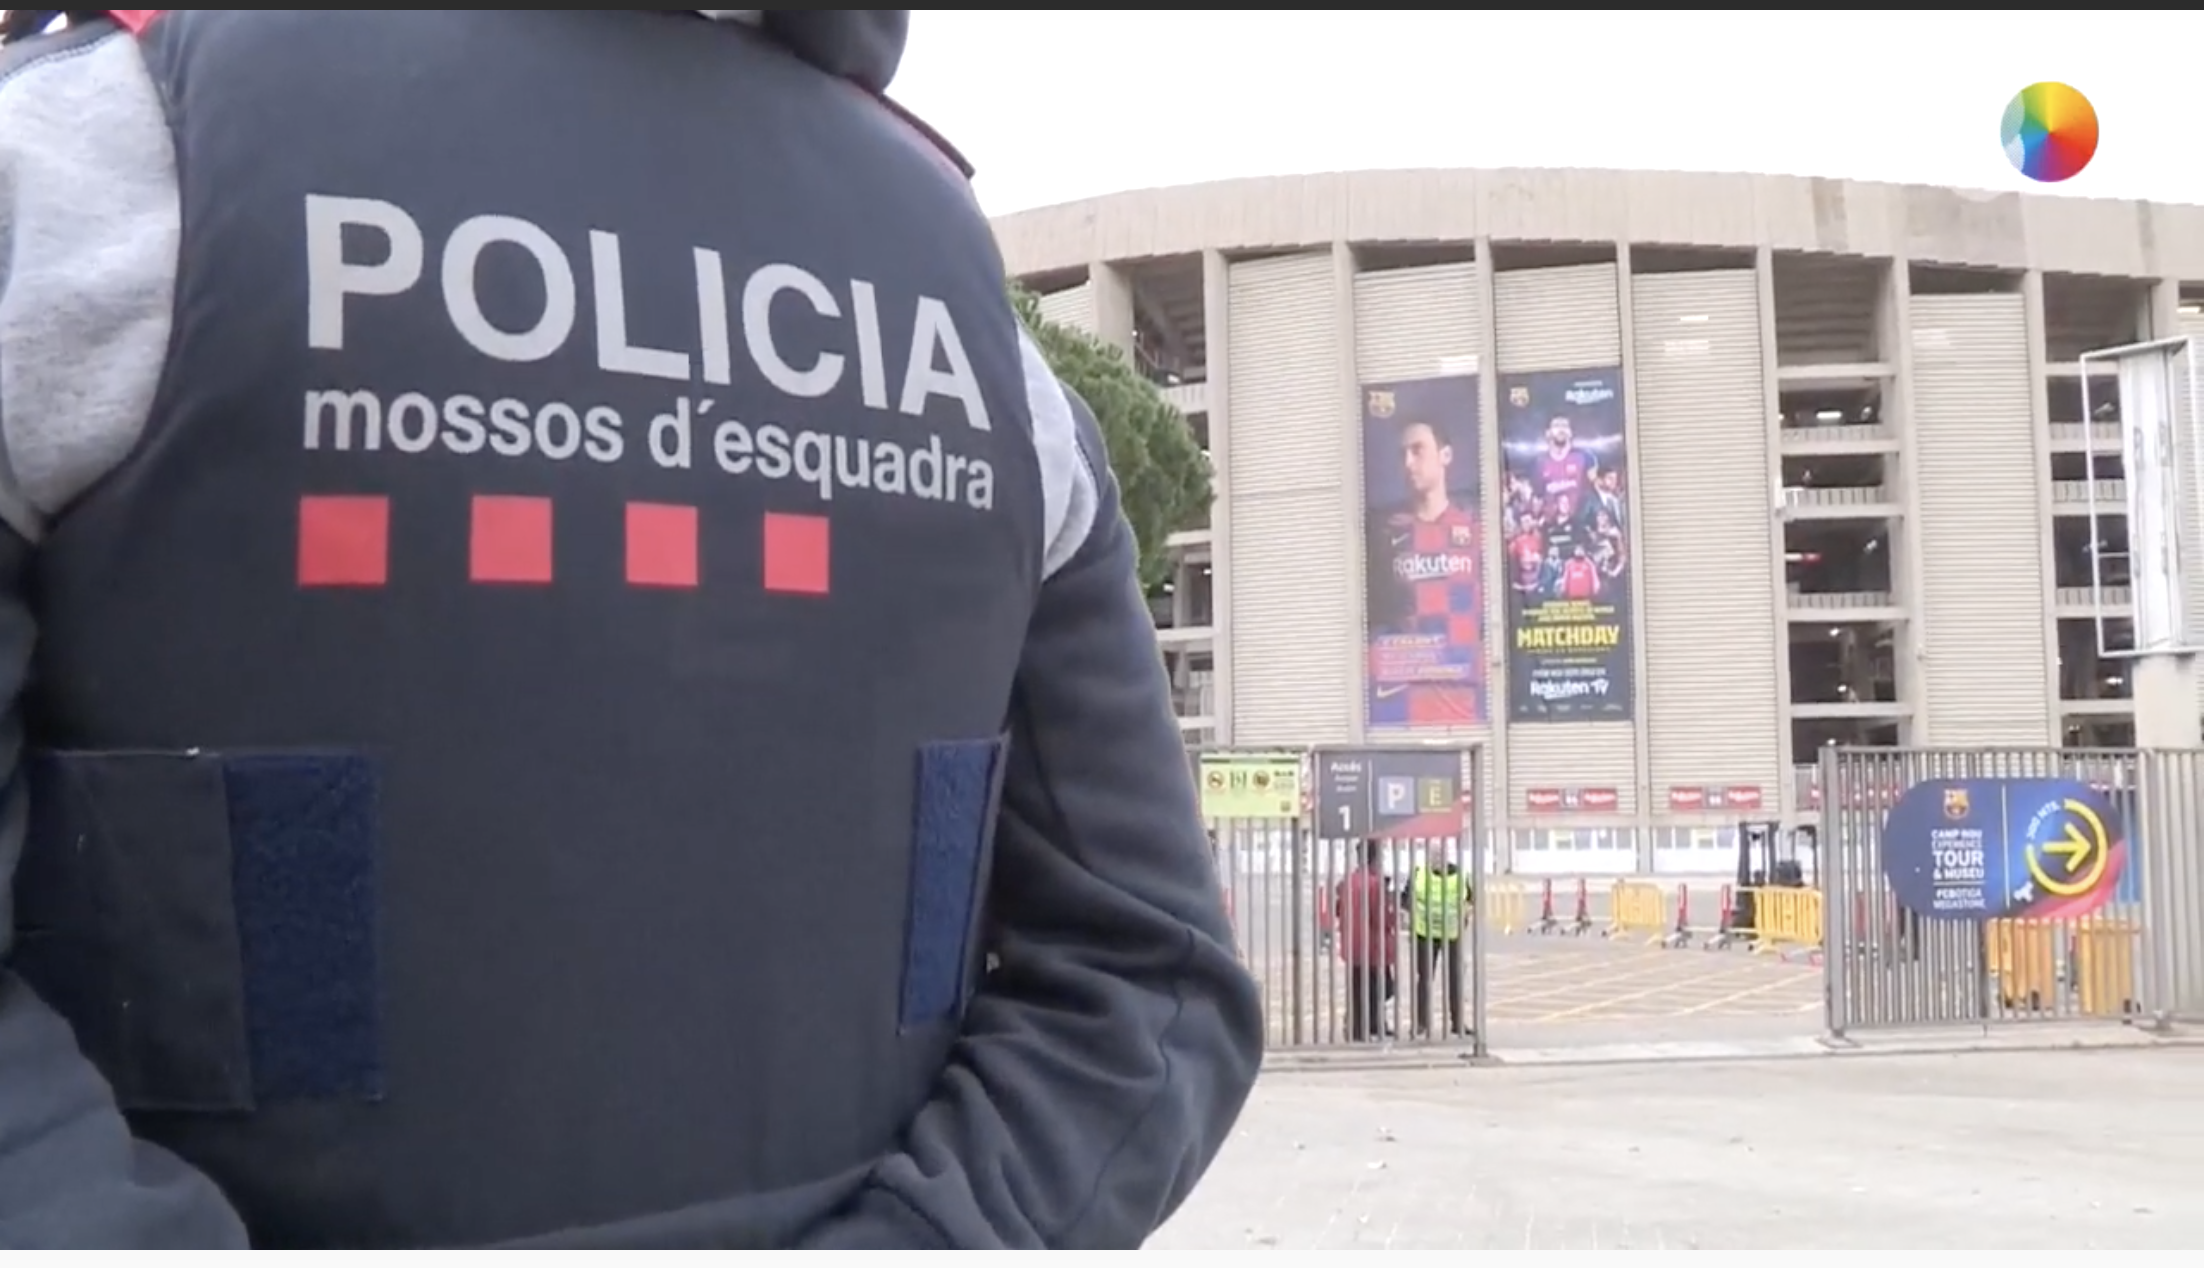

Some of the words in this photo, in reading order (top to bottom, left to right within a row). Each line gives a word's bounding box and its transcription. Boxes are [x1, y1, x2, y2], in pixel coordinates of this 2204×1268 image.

[305, 194, 991, 431] POLICIA
[304, 387, 624, 462] mossos
[1393, 553, 1472, 578] Rakuten
[1517, 625, 1619, 648] MATCHDAY
[1530, 679, 1589, 700] Rakuten
[1388, 782, 1405, 809] P
[1430, 786, 1442, 806] E
[1338, 805, 1350, 831] 1
[1931, 829, 1959, 838] CAMP
[1932, 850, 1984, 867] TOUR
[1944, 867, 1984, 879] MUSEU
